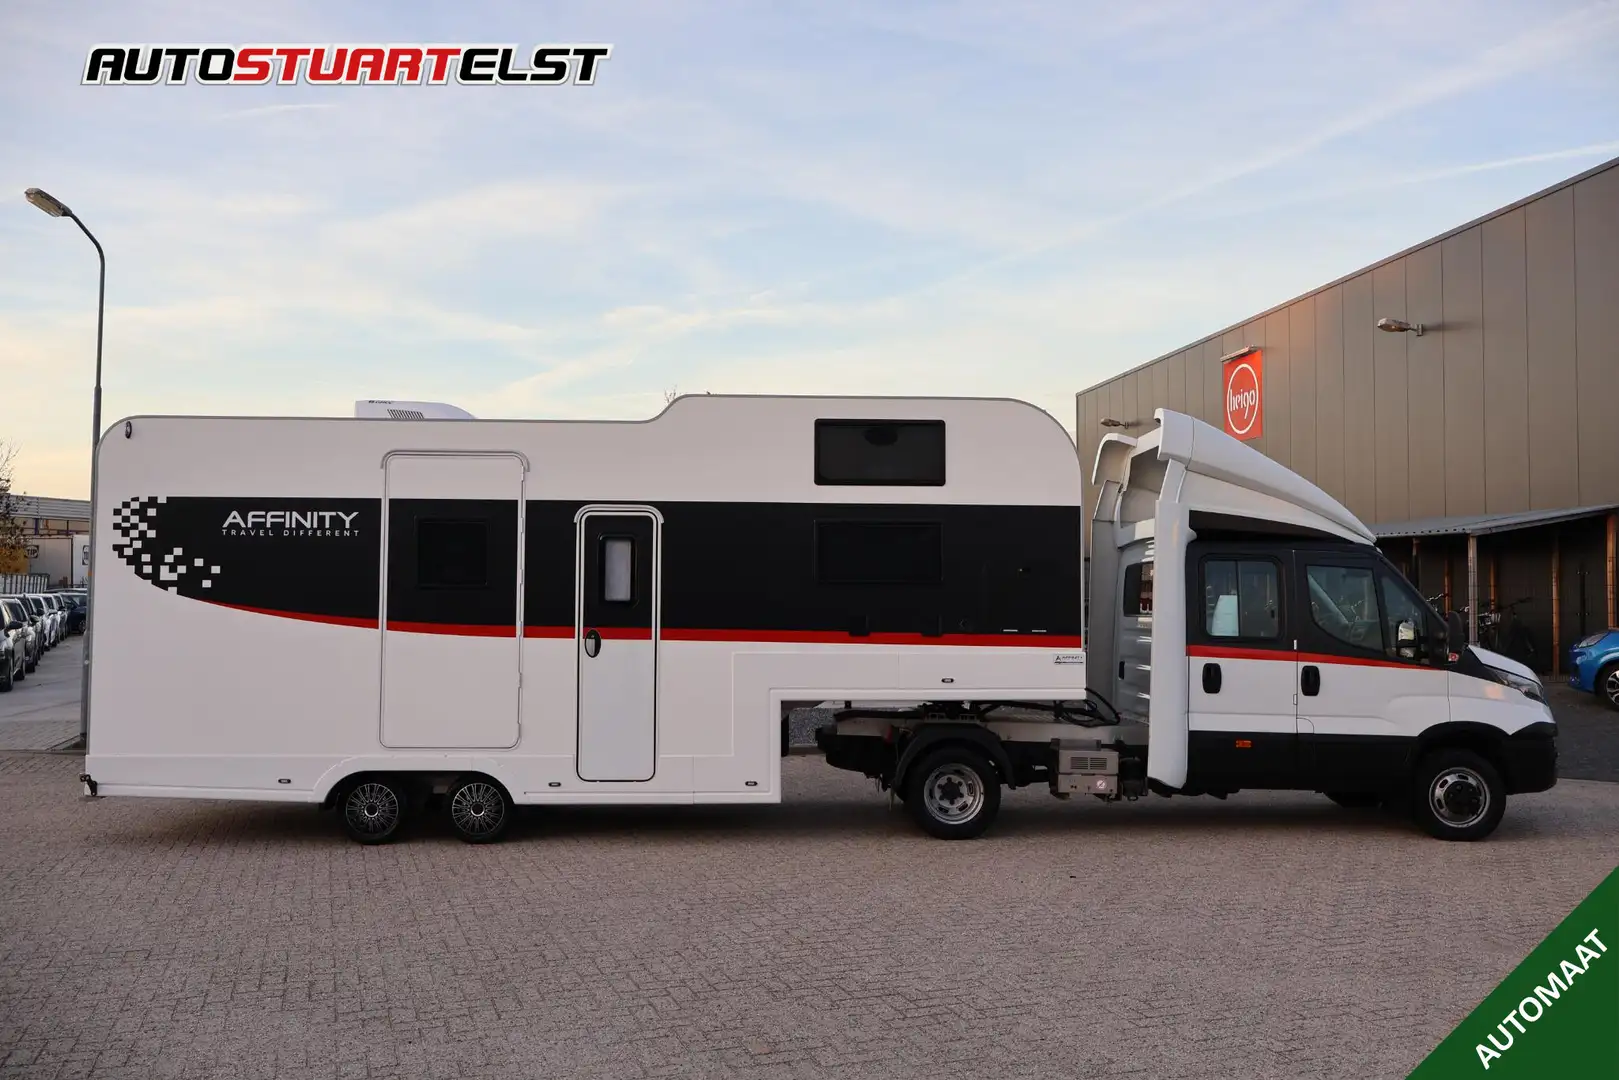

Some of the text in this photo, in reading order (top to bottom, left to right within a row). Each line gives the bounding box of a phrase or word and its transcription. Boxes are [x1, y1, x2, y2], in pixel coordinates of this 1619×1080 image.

[1229, 388, 1256, 420] heigo
[222, 510, 359, 528] AFFINITY
[283, 529, 359, 537] DIFFERENT
